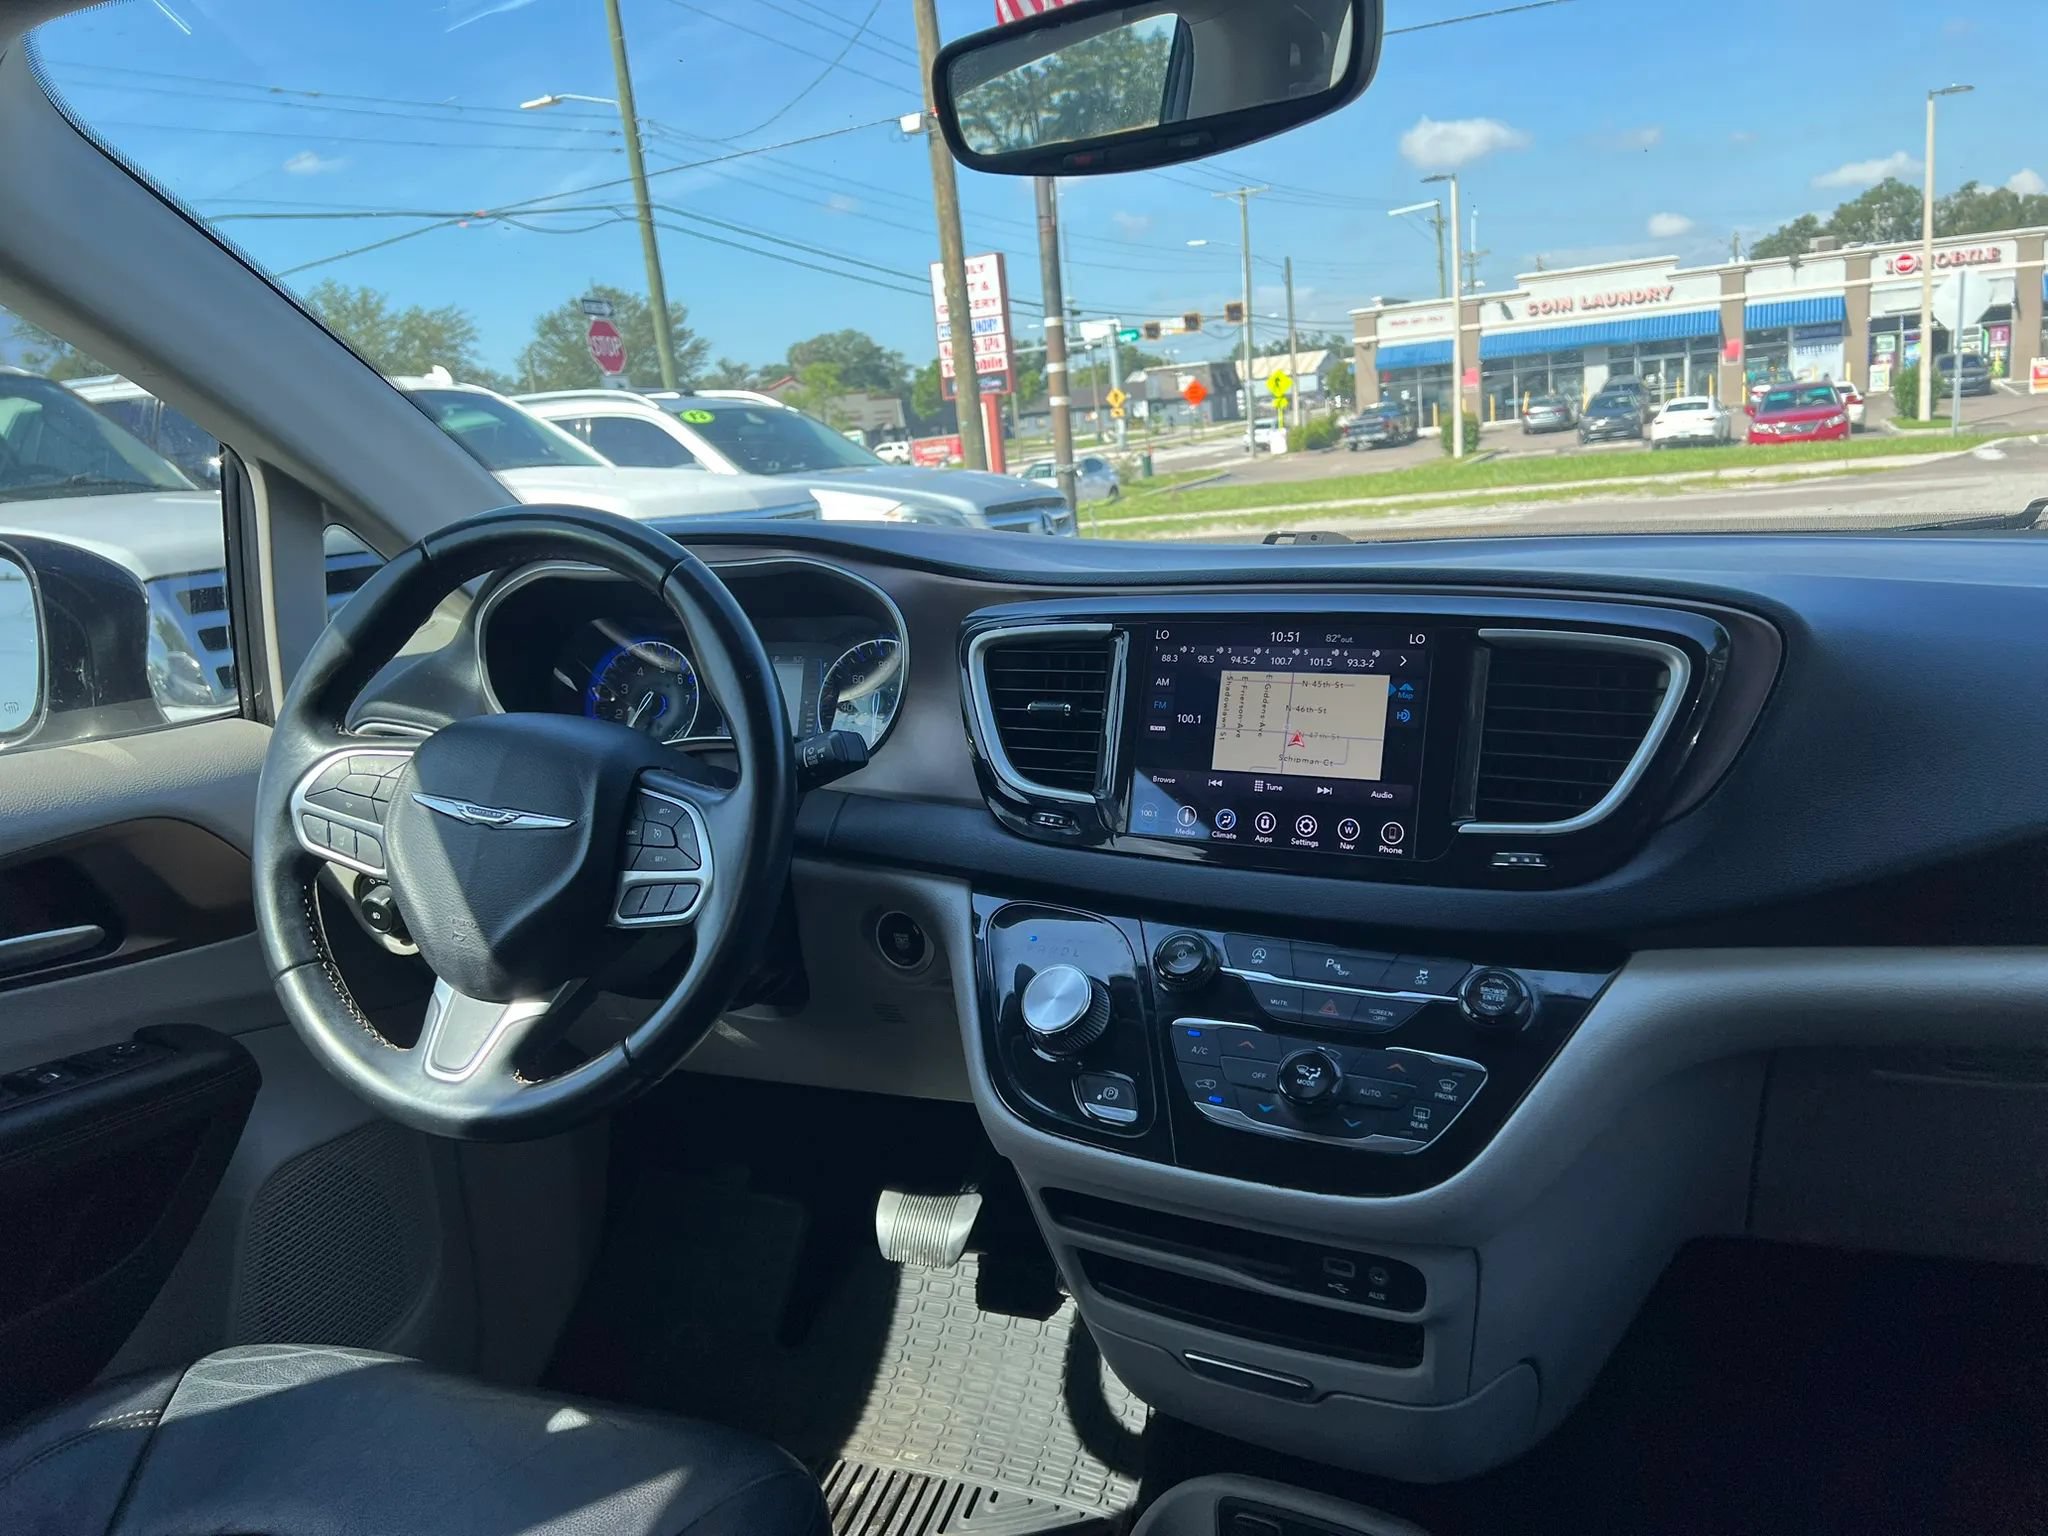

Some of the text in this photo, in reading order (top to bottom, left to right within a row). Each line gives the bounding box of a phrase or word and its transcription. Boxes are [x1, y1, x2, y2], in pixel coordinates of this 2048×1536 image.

[1527, 286, 1675, 316] COIN LAUNDRY
[591, 335, 621, 357] STOP
[1155, 629, 1170, 640] LO
[1270, 631, 1300, 642] 10:51
[1409, 633, 1426, 645] LO
[1161, 654, 1178, 663] 88.3
[1197, 655, 1215, 664] 98.5
[1230, 656, 1257, 665] 94.5-2
[1270, 657, 1293, 666] 100.7
[1309, 658, 1333, 667] 101.5
[1347, 659, 1375, 668] 93.3-2
[636, 666, 644, 677] 4
[677, 673, 684, 685] 6
[852, 674, 865, 684] 60
[1155, 677, 1170, 687] AM
[620, 683, 629, 694] 3
[1311, 680, 1331, 689] 45th
[1260, 683, 1271, 719] Giddens
[1398, 691, 1414, 701] Map
[1153, 700, 1167, 710] FM
[1295, 705, 1314, 713] 46th
[615, 708, 623, 719] 2
[1177, 713, 1202, 724] 100.1
[1152, 775, 1176, 784] Browse
[1266, 783, 1283, 792] Tune
[1370, 790, 1394, 799] Audio
[468, 807, 502, 818] CHRYSLER
[1175, 827, 1196, 836] Media
[1211, 830, 1237, 840] Climate
[1254, 834, 1273, 843] Apps
[1290, 837, 1319, 847] Settings
[1339, 842, 1355, 850] Nav
[1378, 845, 1403, 854] Phone
[1270, 998, 1288, 1007] MUTE
[1368, 1008, 1394, 1017] SCREEN
[1191, 1046, 1208, 1056] A/C
[1251, 1071, 1267, 1080] OFF
[1296, 1078, 1315, 1087] MODE
[1360, 1088, 1381, 1098] AUTO
[1434, 1091, 1458, 1102] FRONT
[1410, 1120, 1429, 1130] REAR
[1367, 1291, 1385, 1300] AUX
